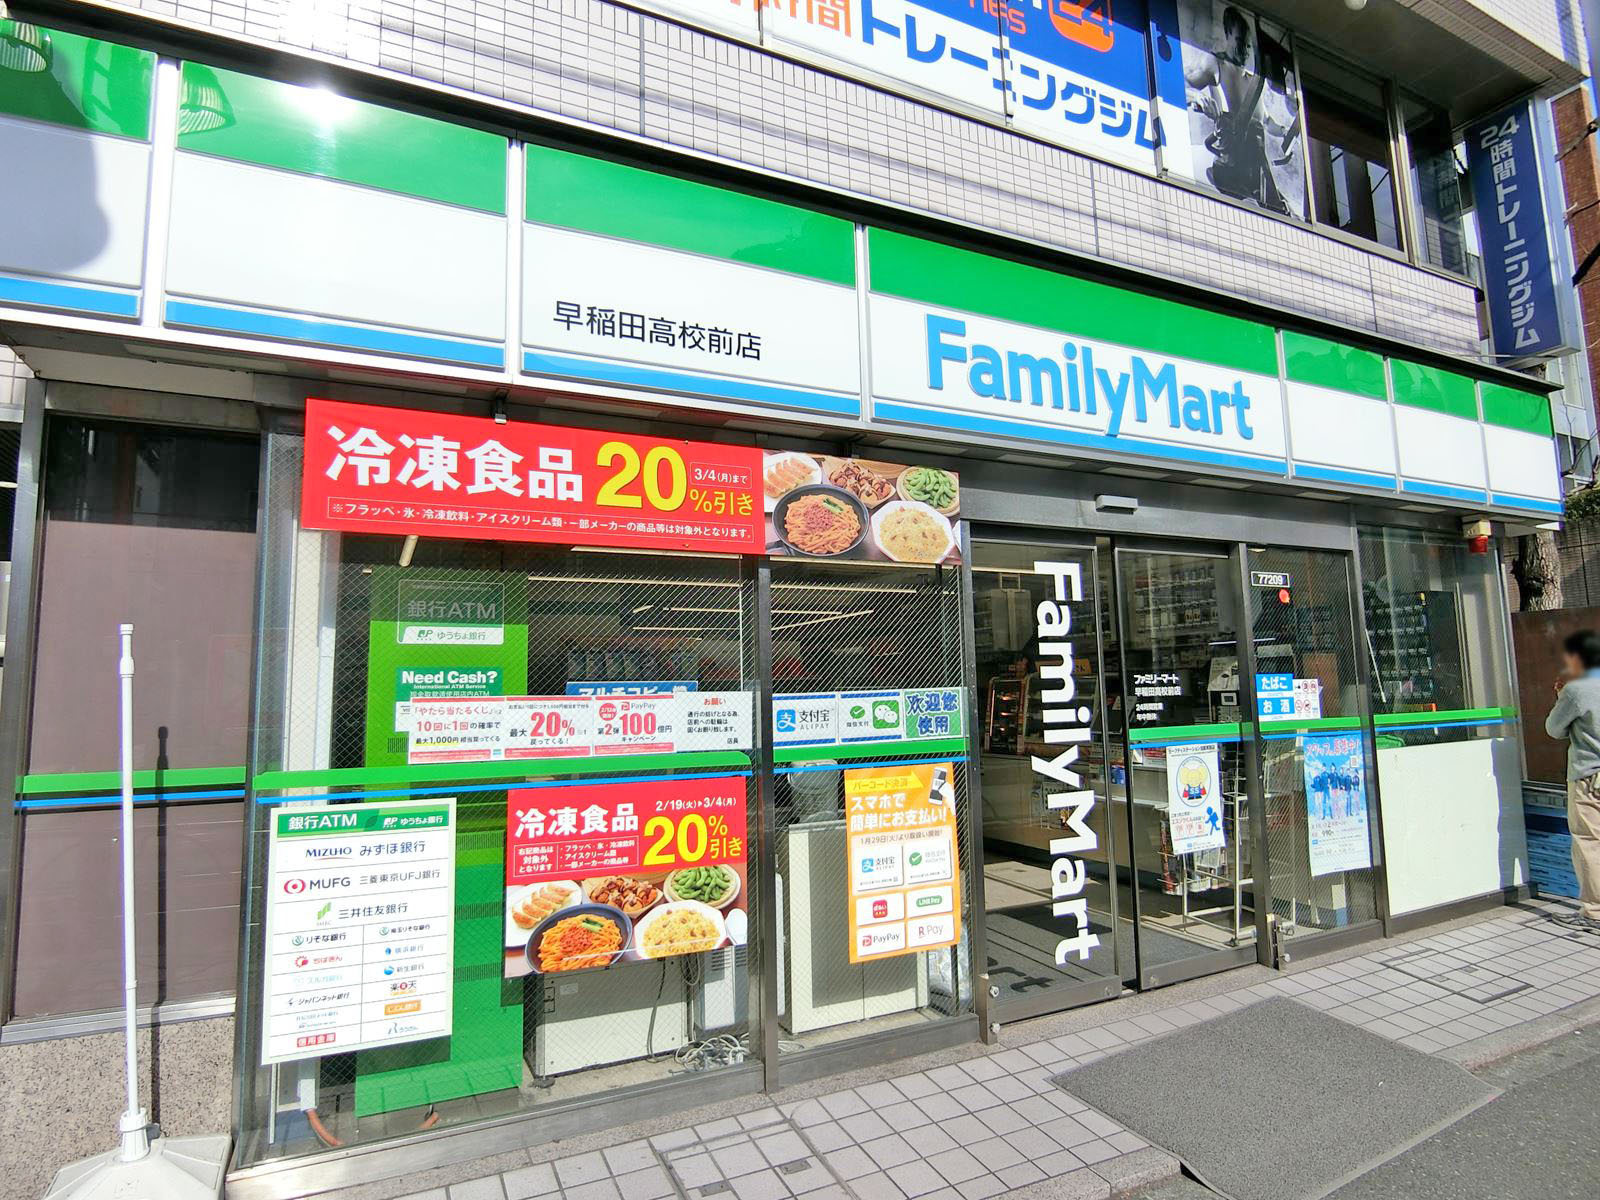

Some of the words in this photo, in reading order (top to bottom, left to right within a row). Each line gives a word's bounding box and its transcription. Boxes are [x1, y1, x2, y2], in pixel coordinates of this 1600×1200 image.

[1479, 115, 1541, 349] 24時間トレーニングジム
[553, 300, 762, 361] 早稲田高校前店
[925, 313, 1254, 441] FamilyMart
[325, 425, 583, 502] 冷凍食品
[595, 441, 688, 512] 20
[694, 468, 748, 485] 3/4(月)まで
[1257, 574, 1284, 585] 77209
[407, 601, 497, 620] 銀行ATM
[437, 630, 488, 641] ゆうちょ銀行
[401, 670, 445, 685] Need
[447, 670, 498, 685] Cash?
[1133, 673, 1180, 685] ファミリーマート
[1261, 676, 1289, 690] たばこ
[630, 702, 657, 710] PayPay
[906, 691, 958, 716] 欢迎您
[619, 712, 657, 736] 100
[798, 709, 831, 723] 支付宝
[916, 715, 950, 735] 使用
[800, 722, 830, 731] ALIPAY
[1031, 560, 1101, 966] FamilyMart
[850, 792, 907, 812] スマホで
[288, 813, 358, 831] 銀行ATM
[400, 816, 444, 826] ゆうちょ銀行
[515, 803, 639, 839] 冷凍食品
[642, 813, 708, 866] 20
[305, 846, 353, 858] MIZUHO
[359, 840, 426, 857] みずほ銀行
[309, 876, 352, 891] MUFG
[359, 869, 441, 886] 三菱東京UFJ銀行
[338, 902, 409, 920] 三井住友銀行
[305, 931, 347, 945] りそな銀行
[873, 932, 900, 944] PayPay
[926, 925, 944, 938] Pay
